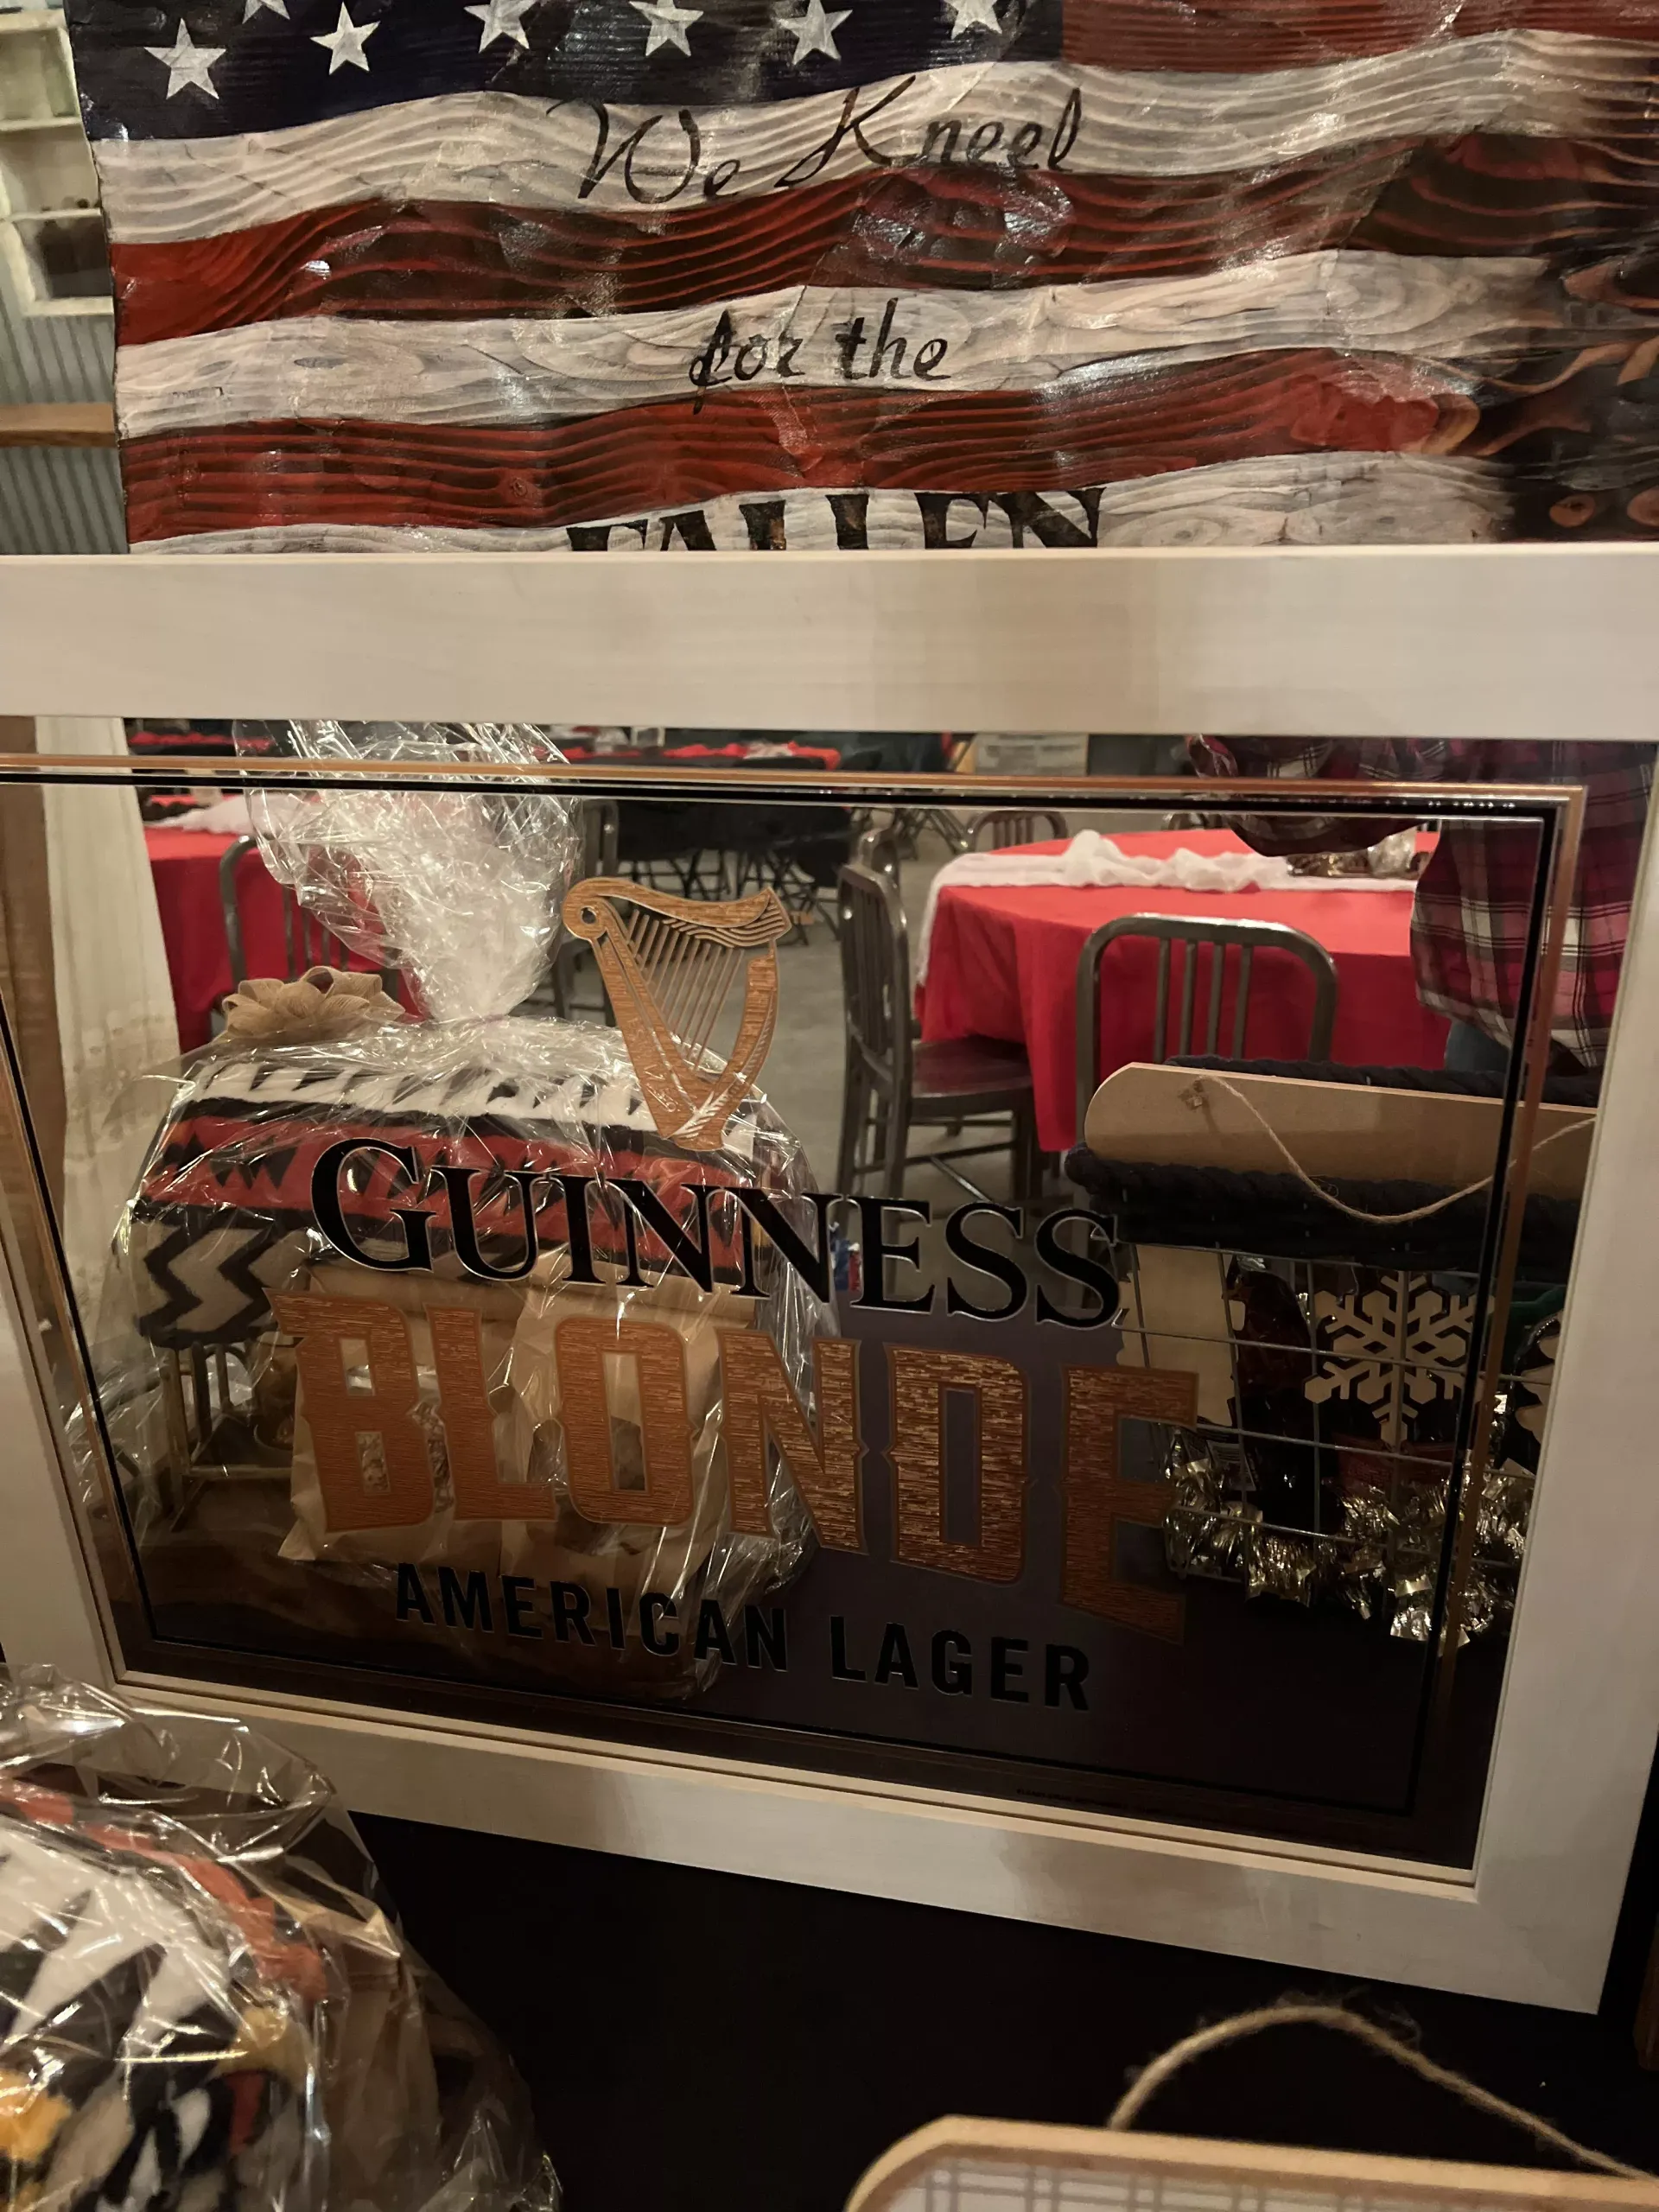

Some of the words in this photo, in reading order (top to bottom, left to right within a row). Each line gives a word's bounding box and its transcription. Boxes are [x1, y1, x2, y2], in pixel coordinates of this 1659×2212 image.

[545, 97, 741, 204] We
[774, 74, 1083, 188] Kneel
[689, 308, 805, 416] for
[833, 296, 951, 380] the
[309, 1137, 1123, 1331] GUINNESS
[264, 1287, 1200, 1644] BLONDE
[394, 1561, 790, 1671] AMERICAN
[829, 1613, 1091, 1712] LAGER
